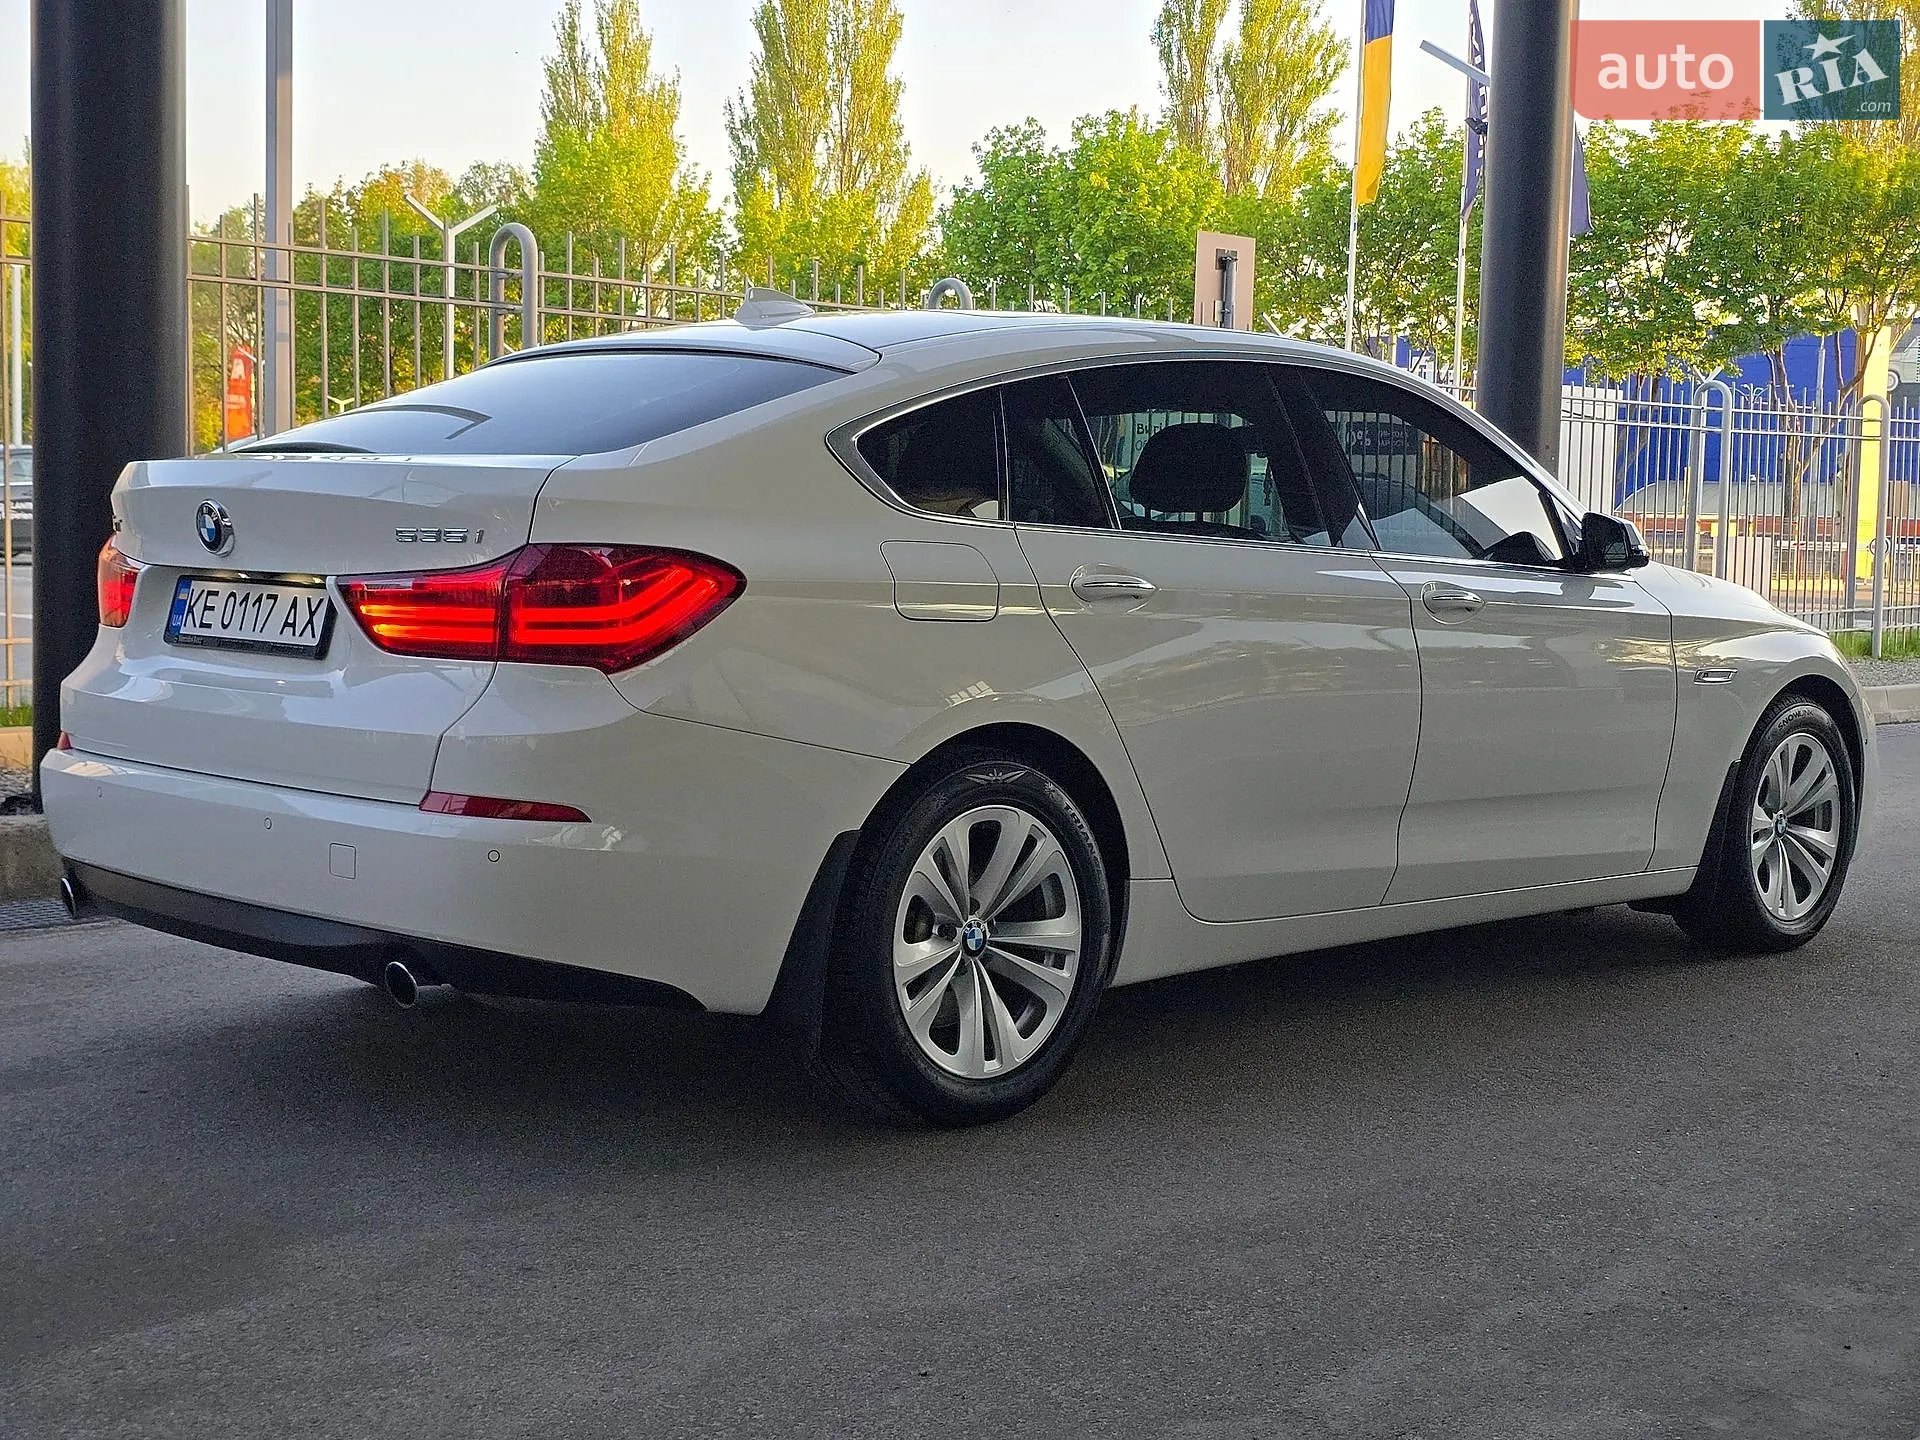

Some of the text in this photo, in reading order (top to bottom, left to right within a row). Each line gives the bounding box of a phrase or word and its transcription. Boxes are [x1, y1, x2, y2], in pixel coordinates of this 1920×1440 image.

[171, 614, 183, 627] UA
[183, 588, 325, 639] KE 0117 AX
